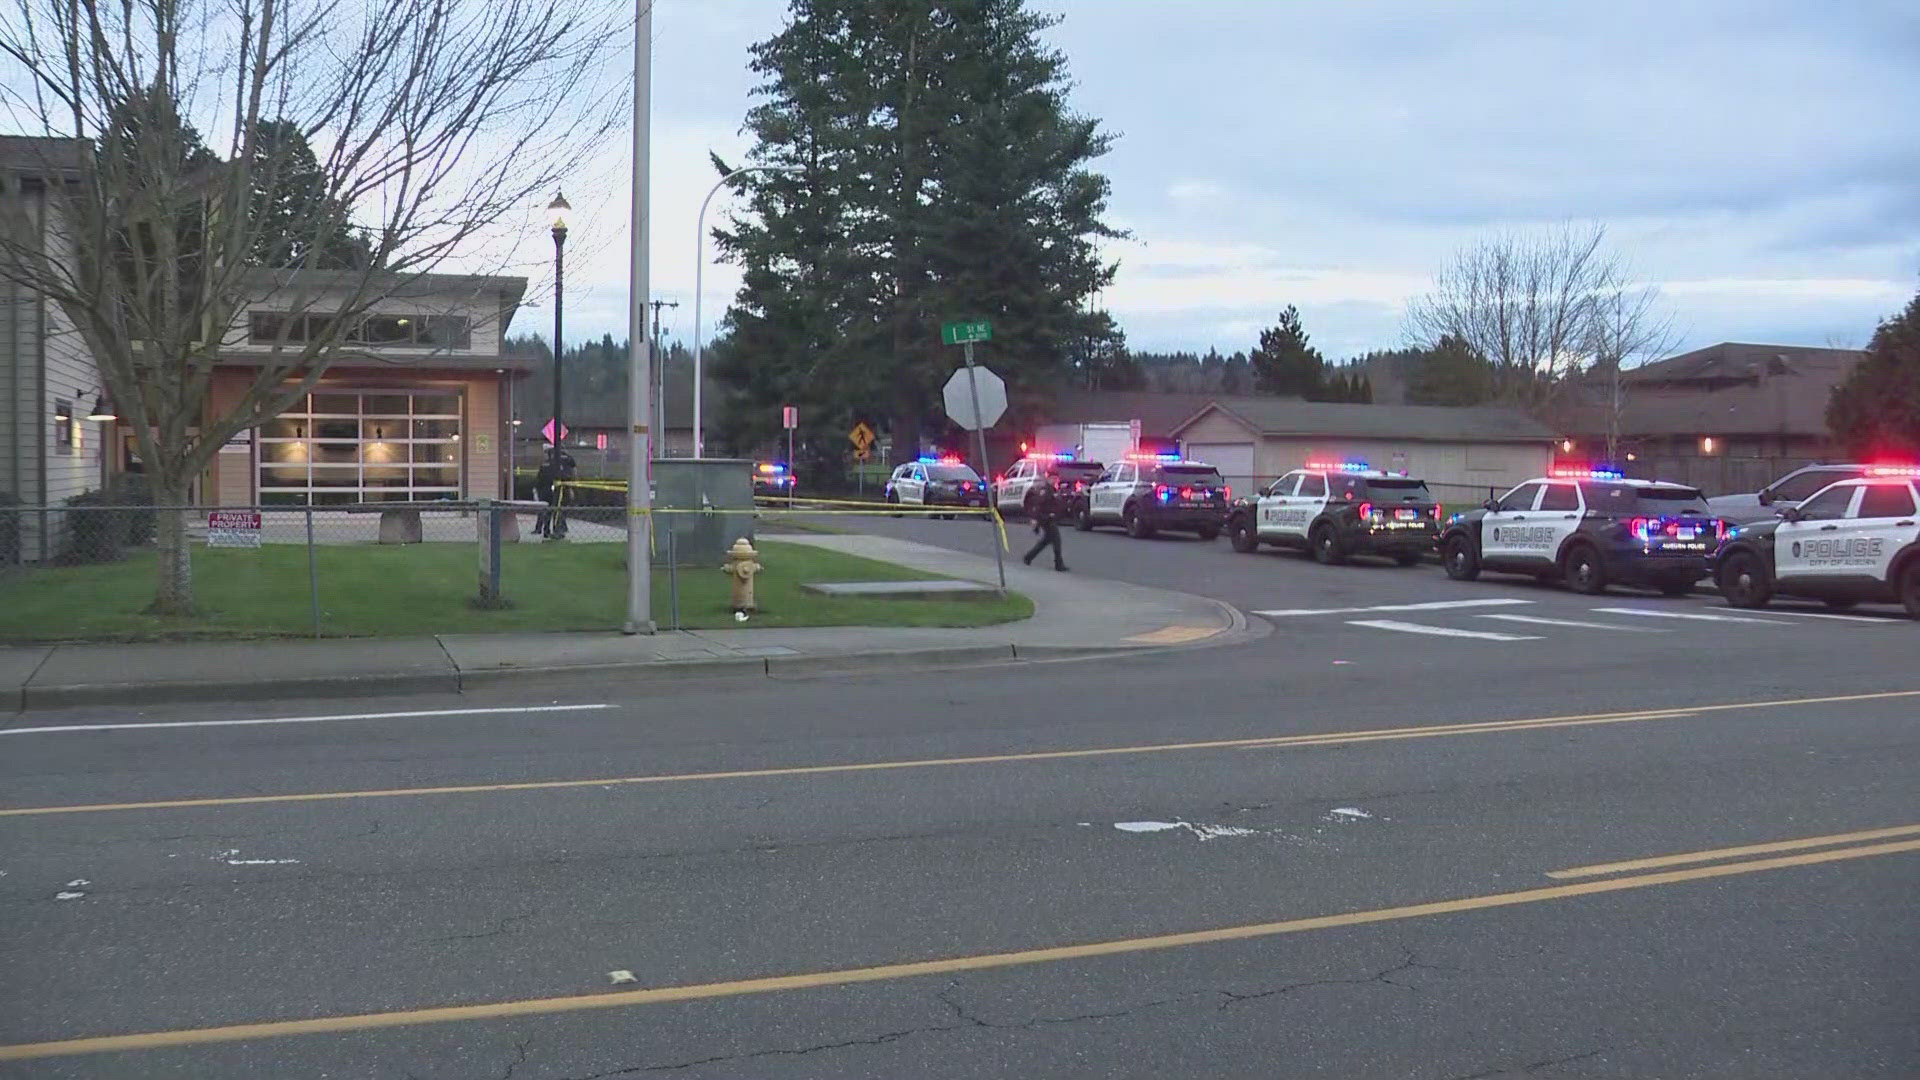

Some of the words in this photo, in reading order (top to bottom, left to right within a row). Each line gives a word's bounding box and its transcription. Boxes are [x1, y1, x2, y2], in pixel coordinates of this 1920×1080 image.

[217, 513, 254, 521] PRIVATE
[211, 520, 258, 528] PROPERTY
[1501, 527, 1555, 542] POLICE
[1662, 542, 1686, 550] AUBURN
[1803, 538, 1883, 558] POLICE
[1809, 559, 1828, 567] CITY
[1830, 559, 1842, 567] OF
